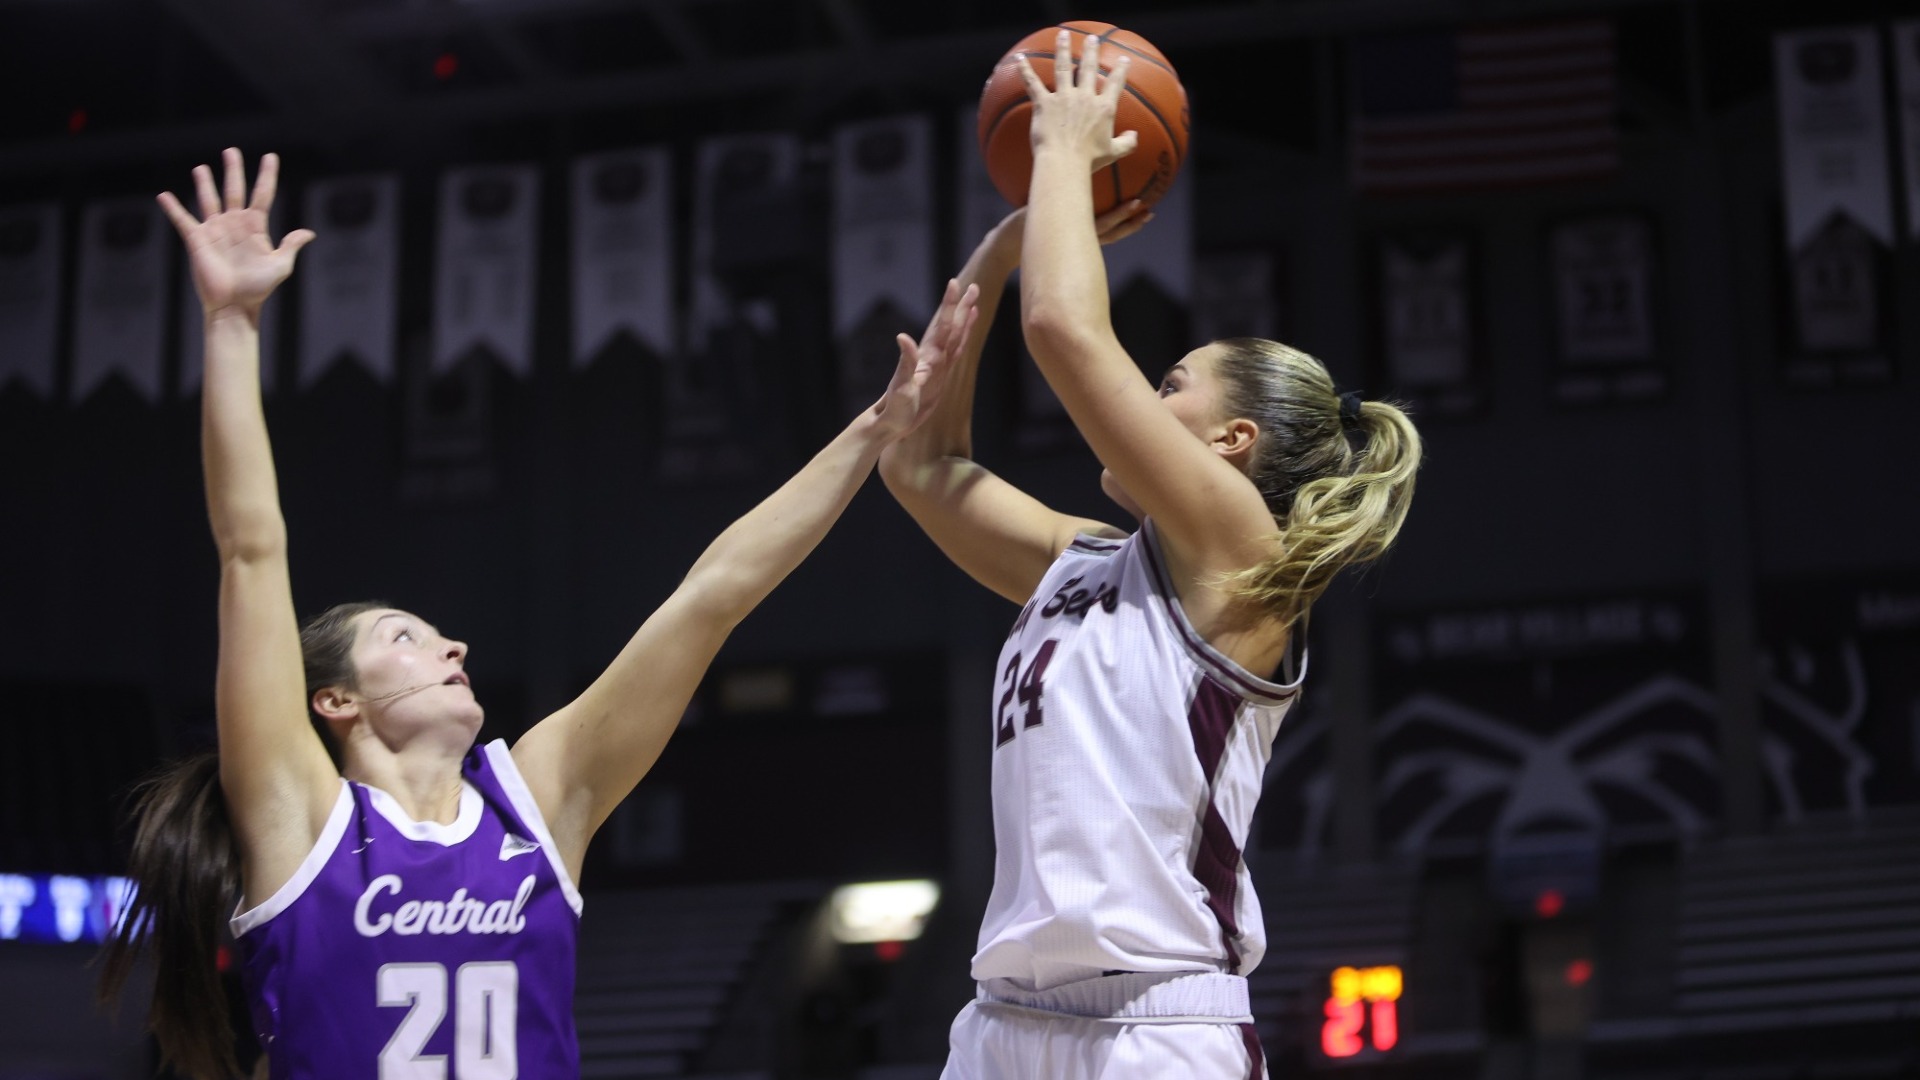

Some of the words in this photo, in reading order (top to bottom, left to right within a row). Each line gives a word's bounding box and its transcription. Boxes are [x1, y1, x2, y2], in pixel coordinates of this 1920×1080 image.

[996, 637, 1060, 750] 24
[353, 873, 536, 938] Central
[376, 960, 519, 1080] 20
